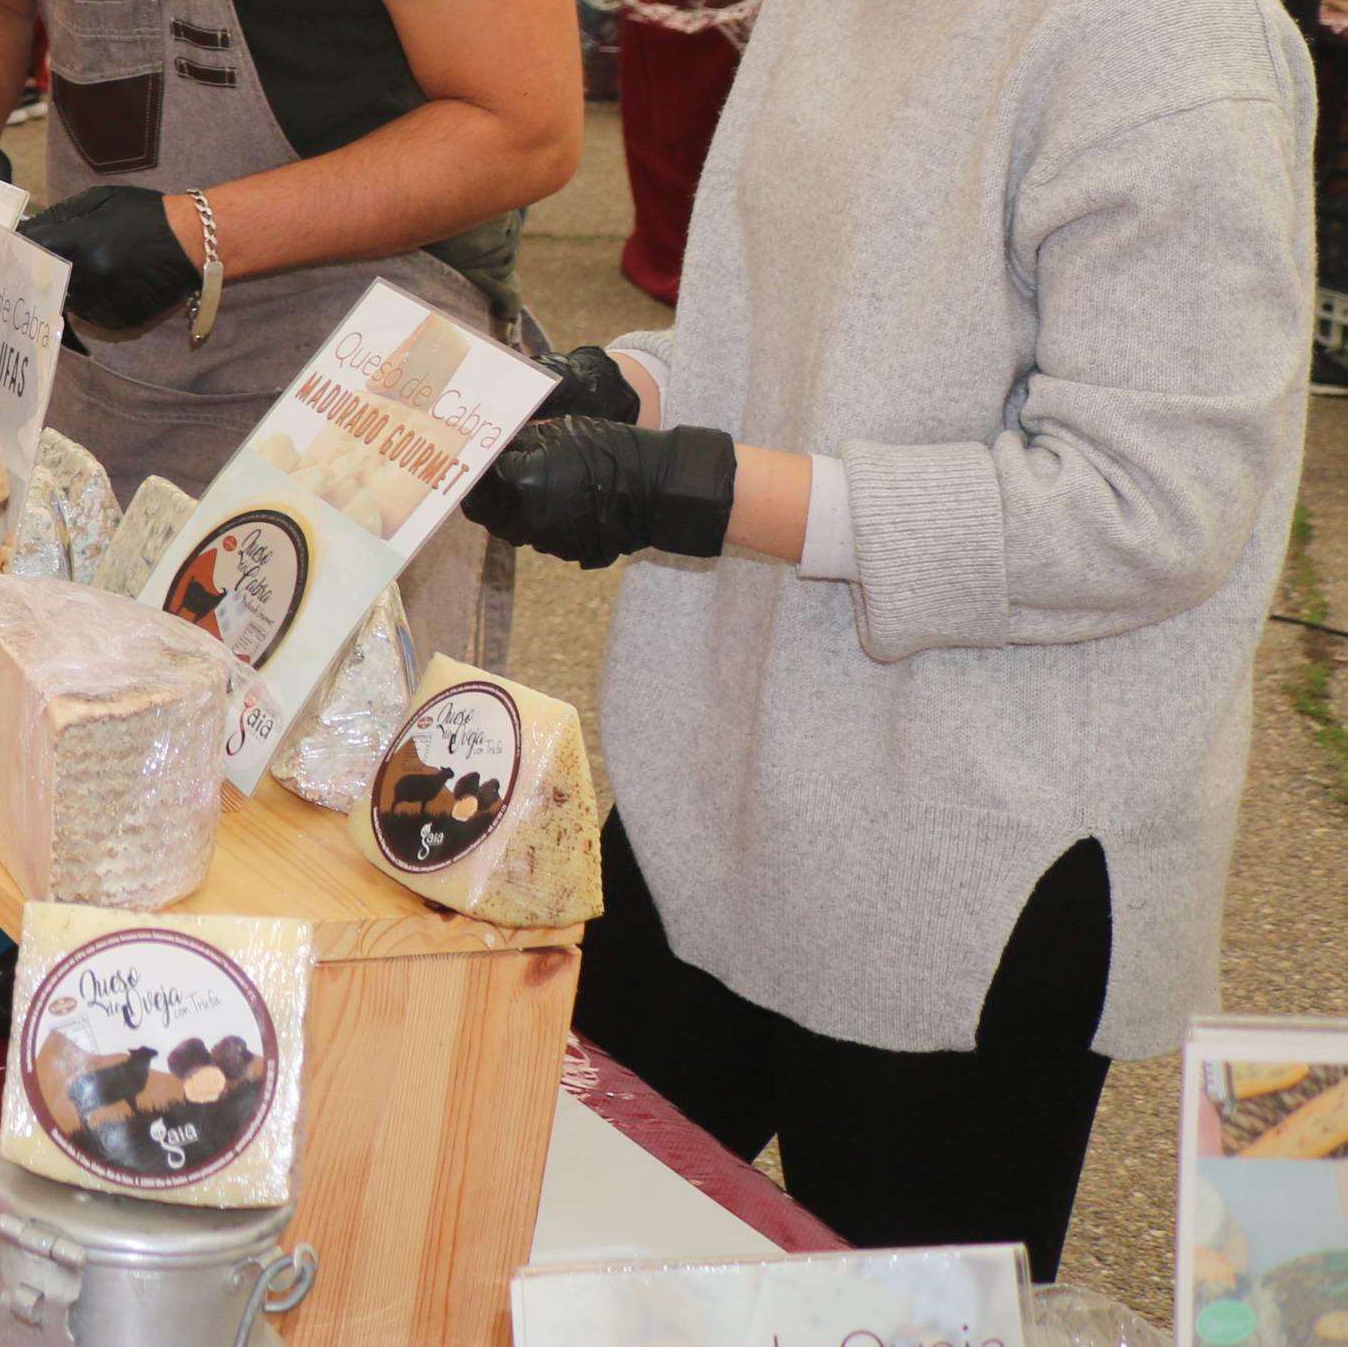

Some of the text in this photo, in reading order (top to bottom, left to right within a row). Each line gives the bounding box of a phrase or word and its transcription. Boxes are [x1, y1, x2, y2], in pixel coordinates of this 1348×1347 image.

[12, 297, 51, 349] Cabra
[334, 331, 503, 450] Queso de Cabra
[294, 371, 471, 497] MADURADO GOURMET
[78, 965, 141, 1008] Queso
[121, 984, 184, 1031] Oveja
[187, 988, 221, 1014] Trufa
